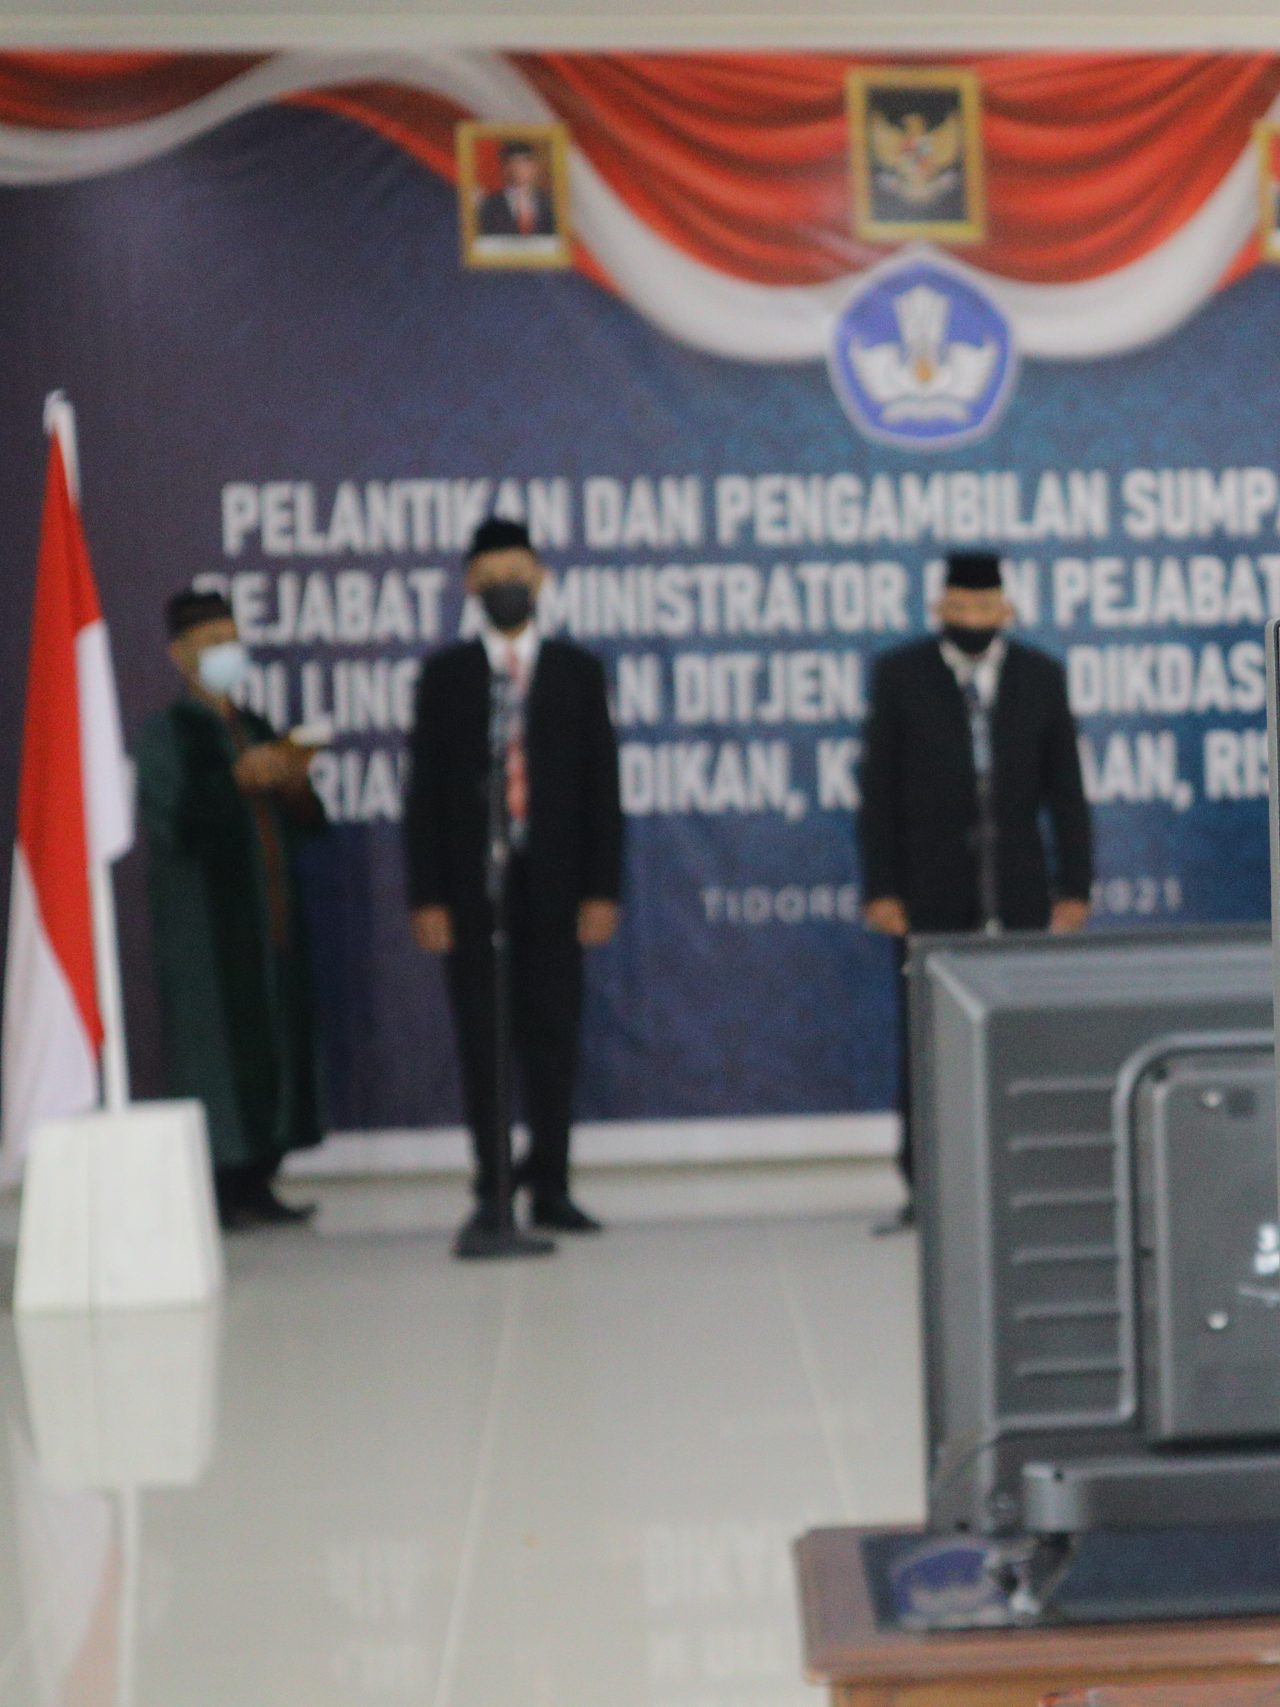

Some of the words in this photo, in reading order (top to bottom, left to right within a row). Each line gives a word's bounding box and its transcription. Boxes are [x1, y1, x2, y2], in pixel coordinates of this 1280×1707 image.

[583, 474, 697, 549] DAN
[716, 470, 1108, 546] PENGAMBILAN
[457, 557, 908, 644] MINISTRATOR
[672, 650, 864, 727] DITJEN
[1066, 640, 1266, 718] DIKDAS
[617, 738, 808, 824] DIKAN,
